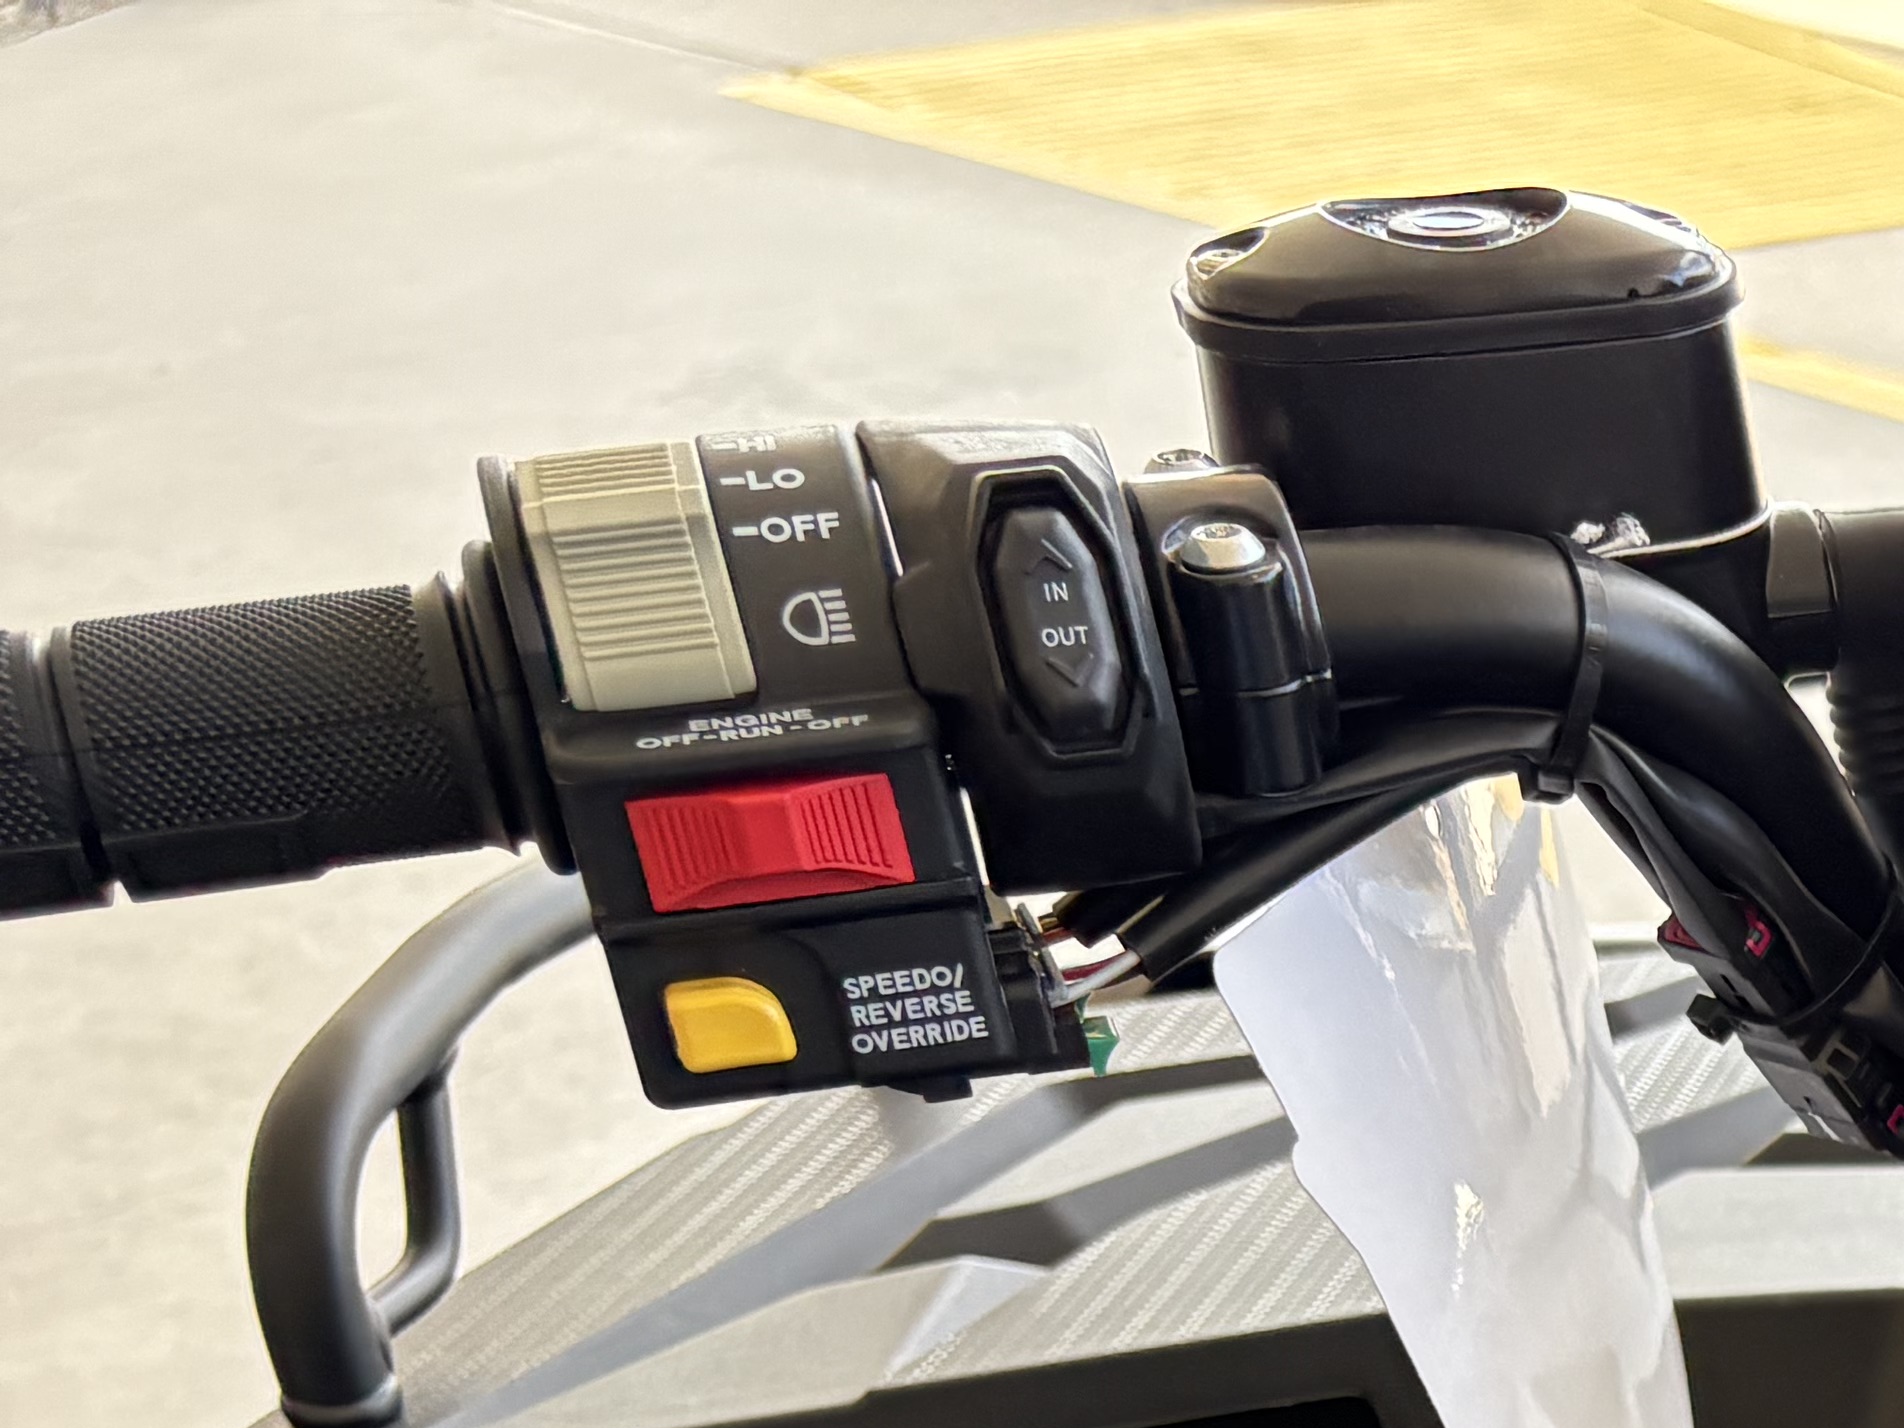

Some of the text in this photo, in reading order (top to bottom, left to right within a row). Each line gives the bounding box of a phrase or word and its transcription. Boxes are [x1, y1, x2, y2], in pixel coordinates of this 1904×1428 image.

[1043, 582, 1069, 602] IN
[1041, 626, 1088, 647] OUT
[688, 709, 813, 733] ENGINE
[843, 962, 963, 999] SPEEDO/
[850, 990, 975, 1027] REVERSE
[852, 1016, 989, 1054] OVERRIDE
